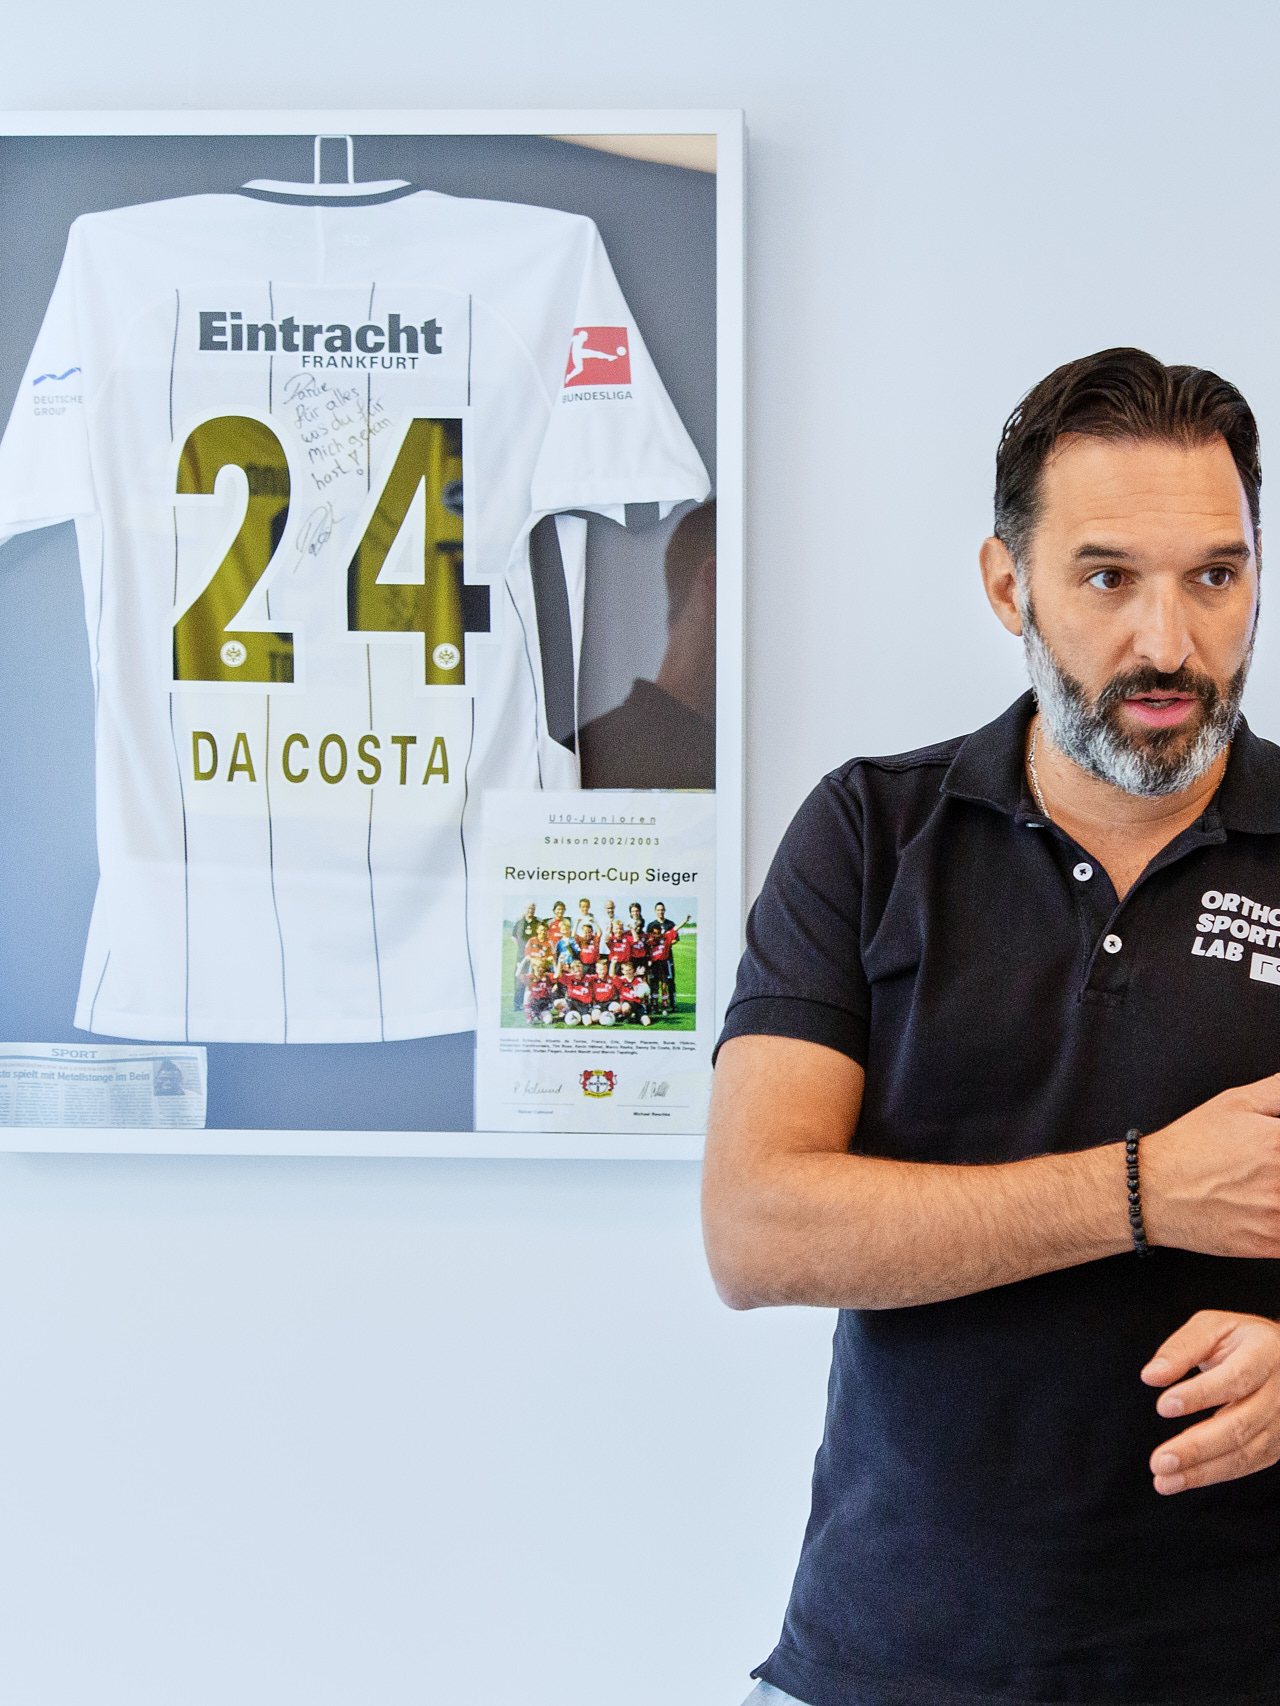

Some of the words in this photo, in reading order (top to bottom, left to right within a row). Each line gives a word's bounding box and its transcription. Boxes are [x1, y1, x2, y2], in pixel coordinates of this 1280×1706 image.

[199, 311, 442, 354] Eintracht
[302, 355, 419, 370] FRANKFURT
[33, 395, 84, 405] DEUTSCHE
[33, 406, 66, 416] GROUP
[173, 415, 491, 685] 24
[192, 730, 257, 782] DA
[282, 733, 449, 785] COSTA
[544, 836, 589, 845] Saison
[593, 836, 660, 846] 2002/2003
[504, 866, 640, 884] Reviersport-Cup
[645, 868, 698, 886] Sieger
[1191, 937, 1245, 962] LAB
[51, 1048, 98, 1059] SPORT
[13, 1070, 38, 1081] spielt
[41, 1071, 55, 1080] mit
[115, 1072, 127, 1081] im
[129, 1072, 150, 1081] Bein
